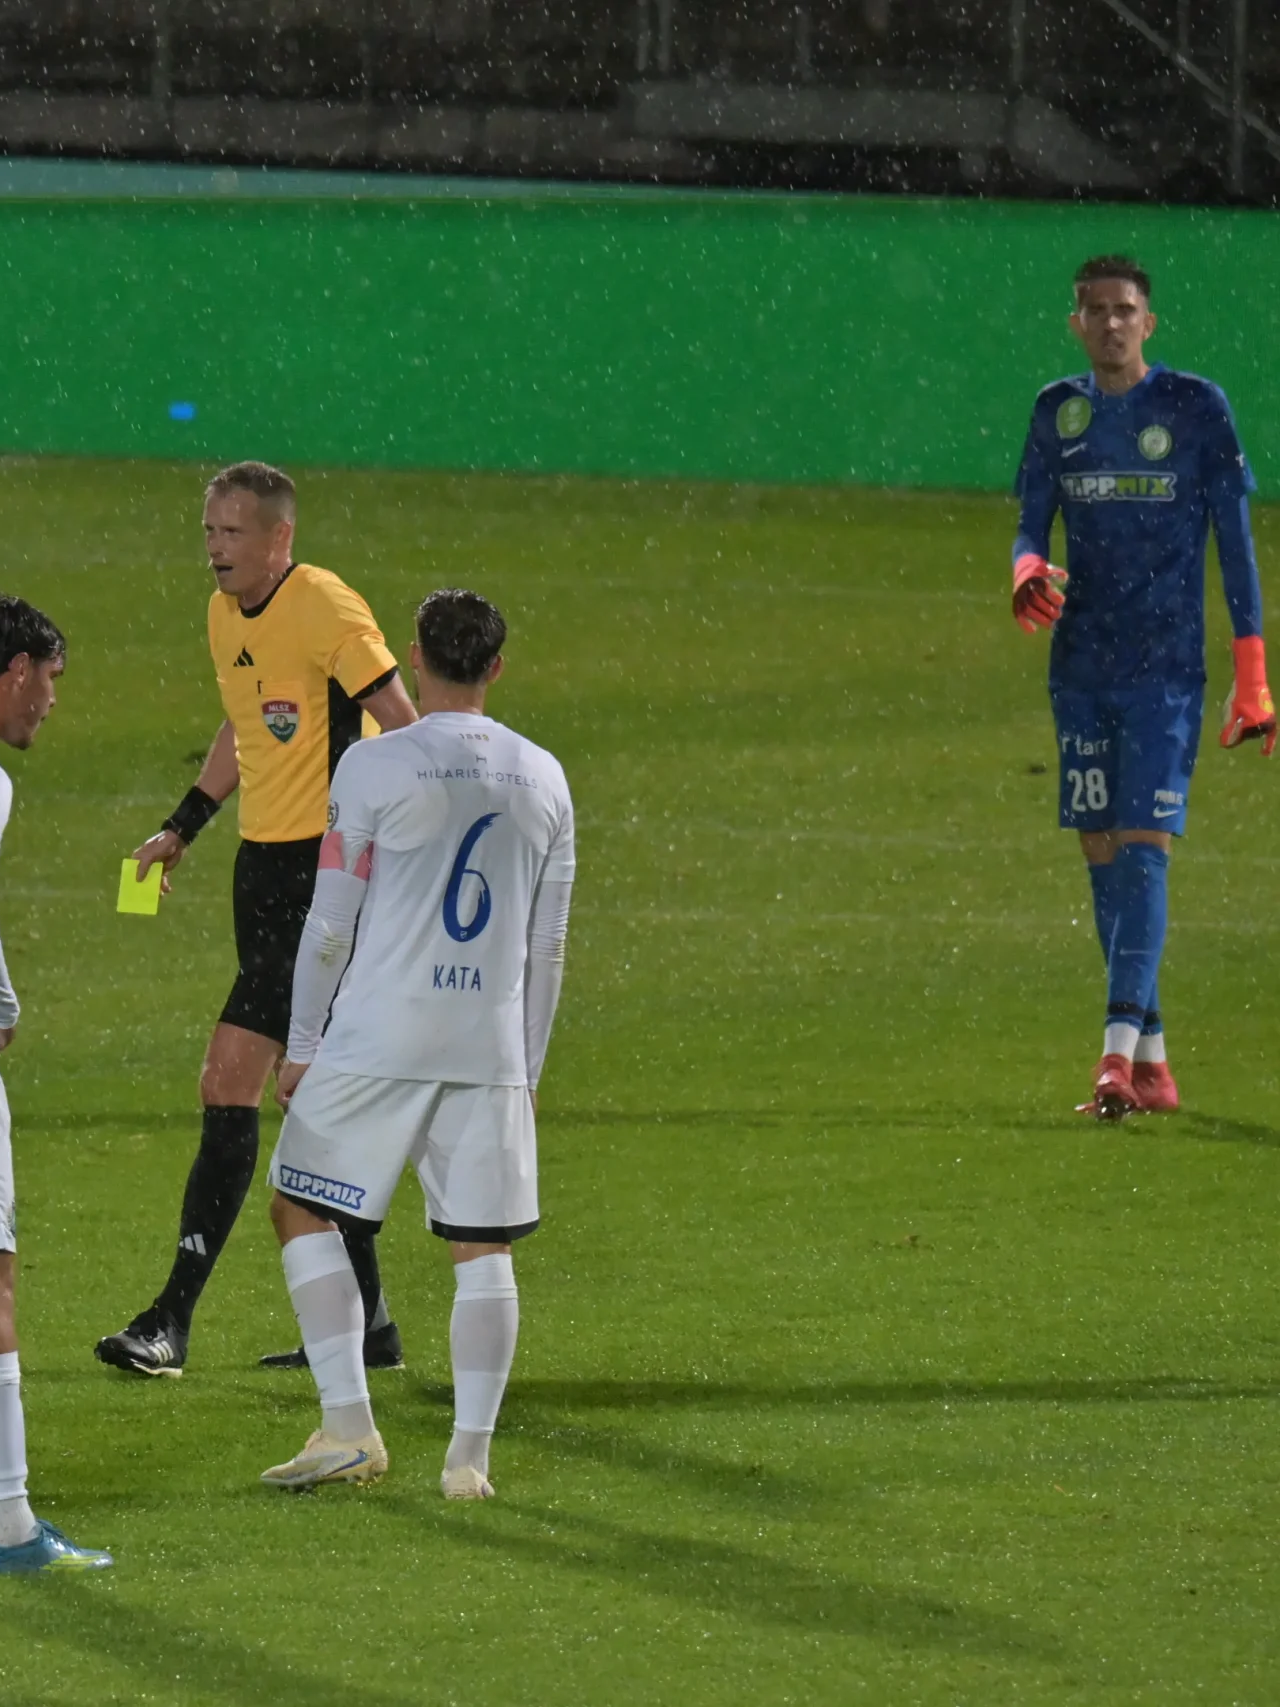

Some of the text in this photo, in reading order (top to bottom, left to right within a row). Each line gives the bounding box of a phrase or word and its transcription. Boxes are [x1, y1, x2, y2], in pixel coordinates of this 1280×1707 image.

[268, 704, 290, 712] MLSZ
[417, 768, 538, 789] HILARIS HOTELS
[1067, 768, 1108, 812] 28
[442, 812, 503, 943] 6
[433, 964, 482, 991] KATA
[281, 1167, 363, 1208] TiPPMIX
